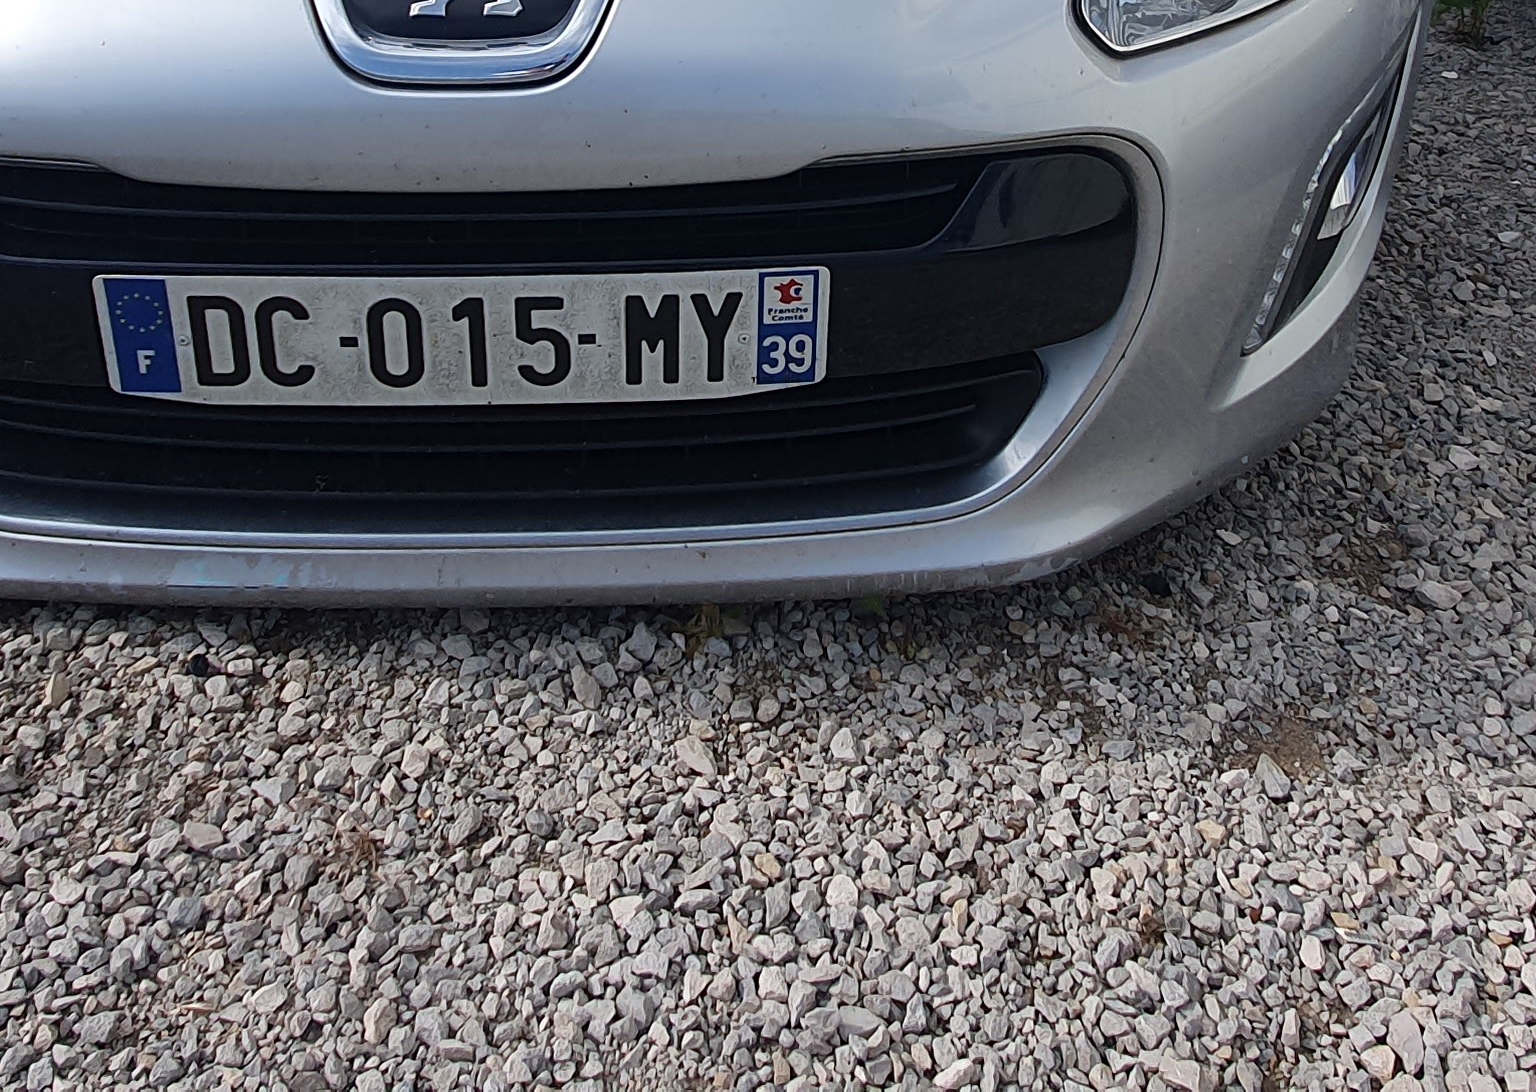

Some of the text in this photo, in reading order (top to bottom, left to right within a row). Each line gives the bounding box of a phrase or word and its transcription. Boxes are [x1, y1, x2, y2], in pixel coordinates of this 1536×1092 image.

[767, 307, 809, 316] Franche
[137, 350, 155, 374] F
[761, 333, 813, 375] 39
